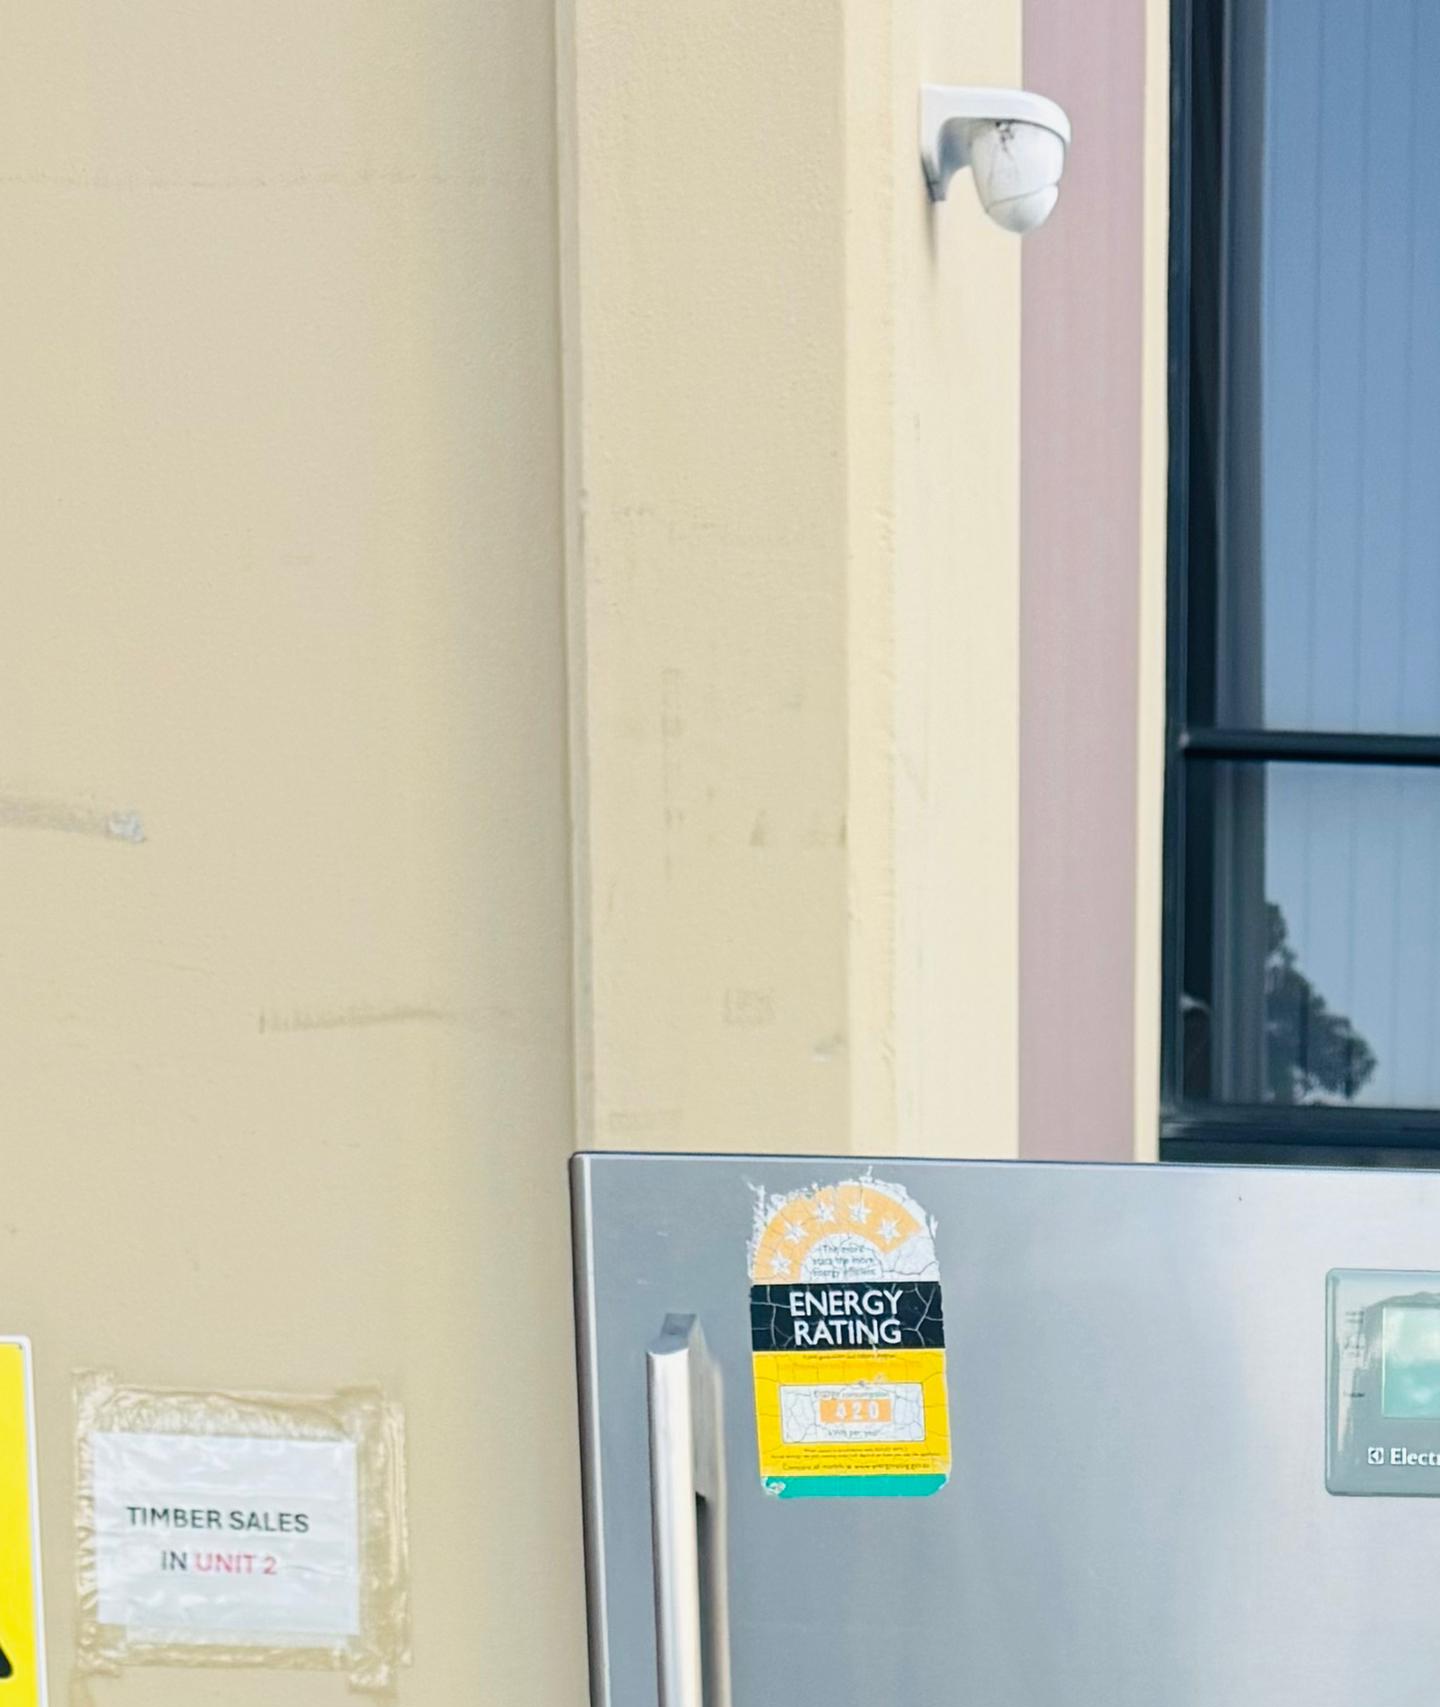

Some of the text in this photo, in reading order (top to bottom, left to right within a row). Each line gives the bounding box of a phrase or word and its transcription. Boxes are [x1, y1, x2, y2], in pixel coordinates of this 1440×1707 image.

[789, 1289, 904, 1316] ENERGY
[794, 1318, 902, 1346] RATING
[835, 1400, 880, 1420] 420
[126, 1506, 310, 1533] TIMBER SALES
[161, 1550, 278, 1576] IN UNIT 2
